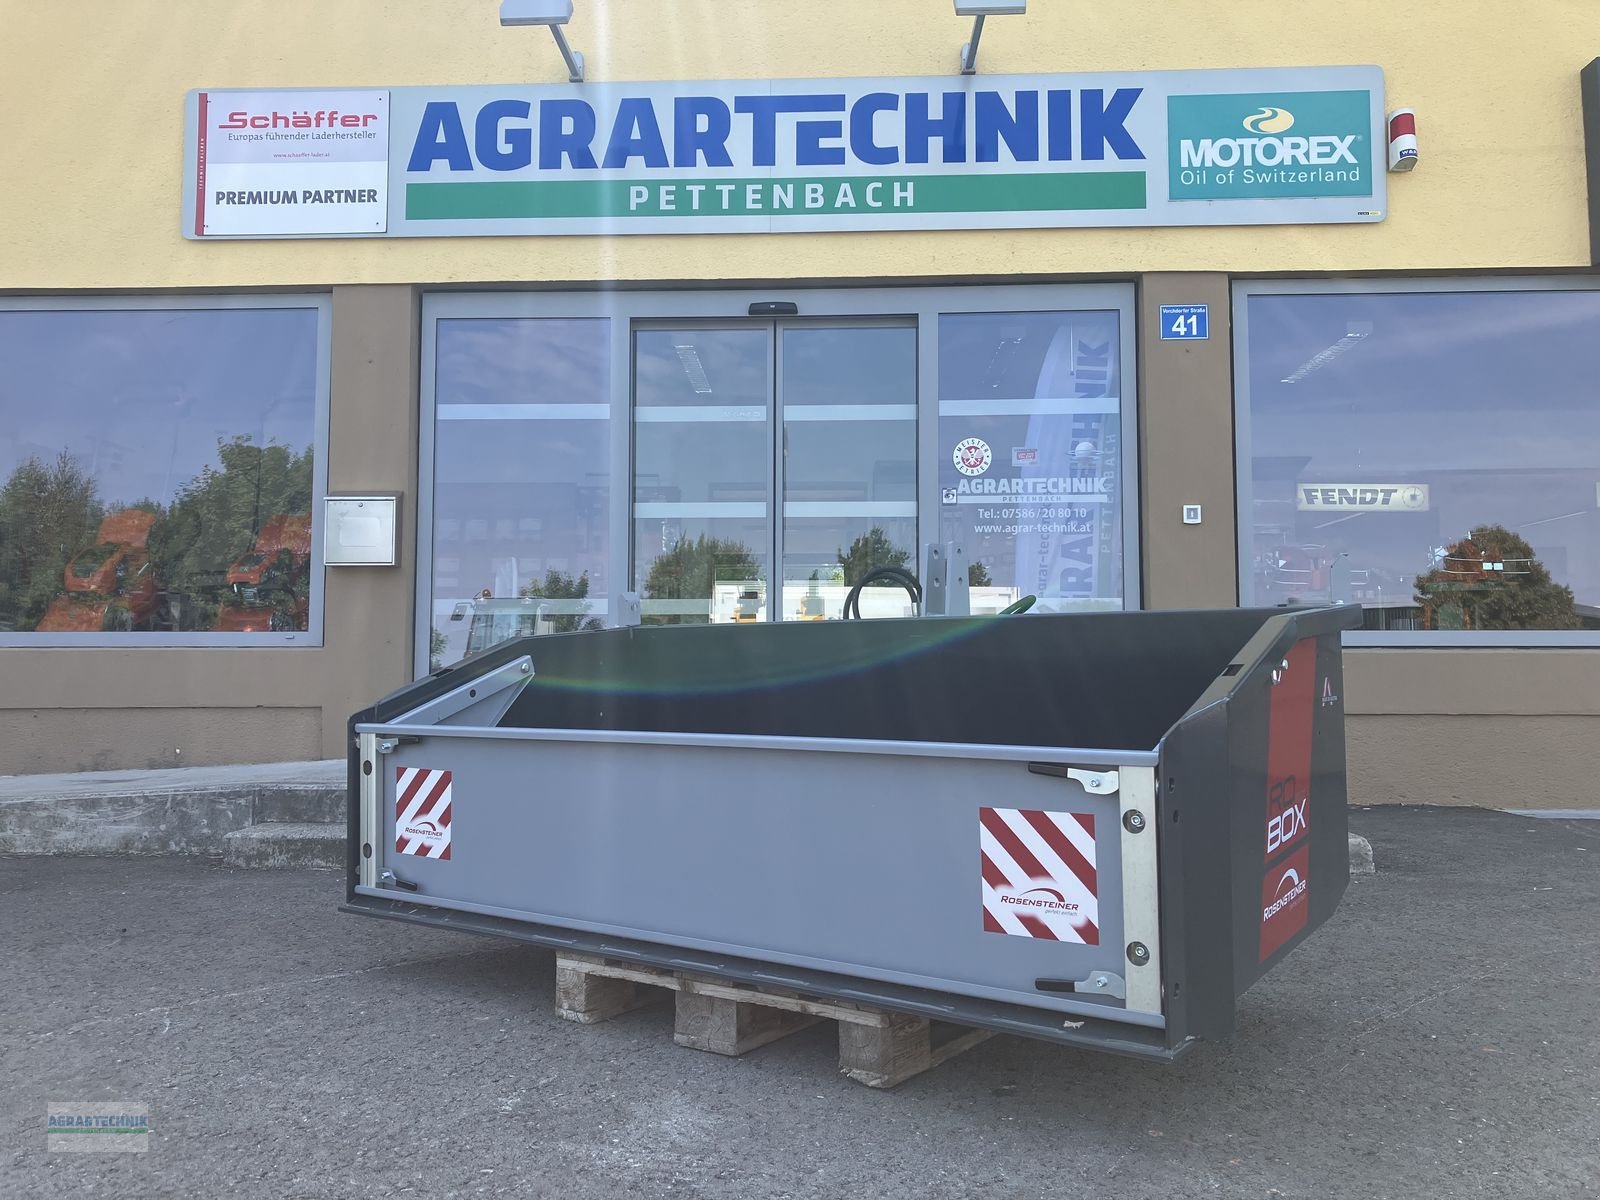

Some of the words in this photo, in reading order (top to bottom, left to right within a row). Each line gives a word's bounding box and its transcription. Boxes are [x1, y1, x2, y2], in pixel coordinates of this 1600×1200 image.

[218, 111, 378, 129] Schäffer
[228, 132, 263, 143] Europas
[265, 131, 309, 141] führender
[311, 130, 377, 140] Laderhersteller
[406, 88, 1147, 172] AGRARTECHNIK
[1180, 135, 1358, 168] MOTOREX
[1181, 170, 1206, 185] Oil
[1216, 169, 1234, 184] of
[1243, 167, 1360, 184] Switzerland
[215, 190, 298, 205] PREMIUM
[302, 189, 377, 204] PARTNER
[629, 181, 914, 211] PETTENBACH
[1171, 315, 1197, 335] 41
[956, 439, 989, 453] MEISTER
[957, 477, 1108, 494] AGRARTECHNIK
[1302, 488, 1398, 505] FENDT
[978, 508, 1000, 519] Tel.:
[1058, 508, 1071, 518] 80
[1074, 508, 1087, 518] 10
[973, 522, 1091, 535] www.agrar-technik.at
[404, 827, 443, 837] ROSENSTEINER
[1267, 798, 1307, 853] BOX
[1000, 895, 1079, 911] ROSENSTEINER
[1263, 879, 1306, 922] ROSENSTEINER
